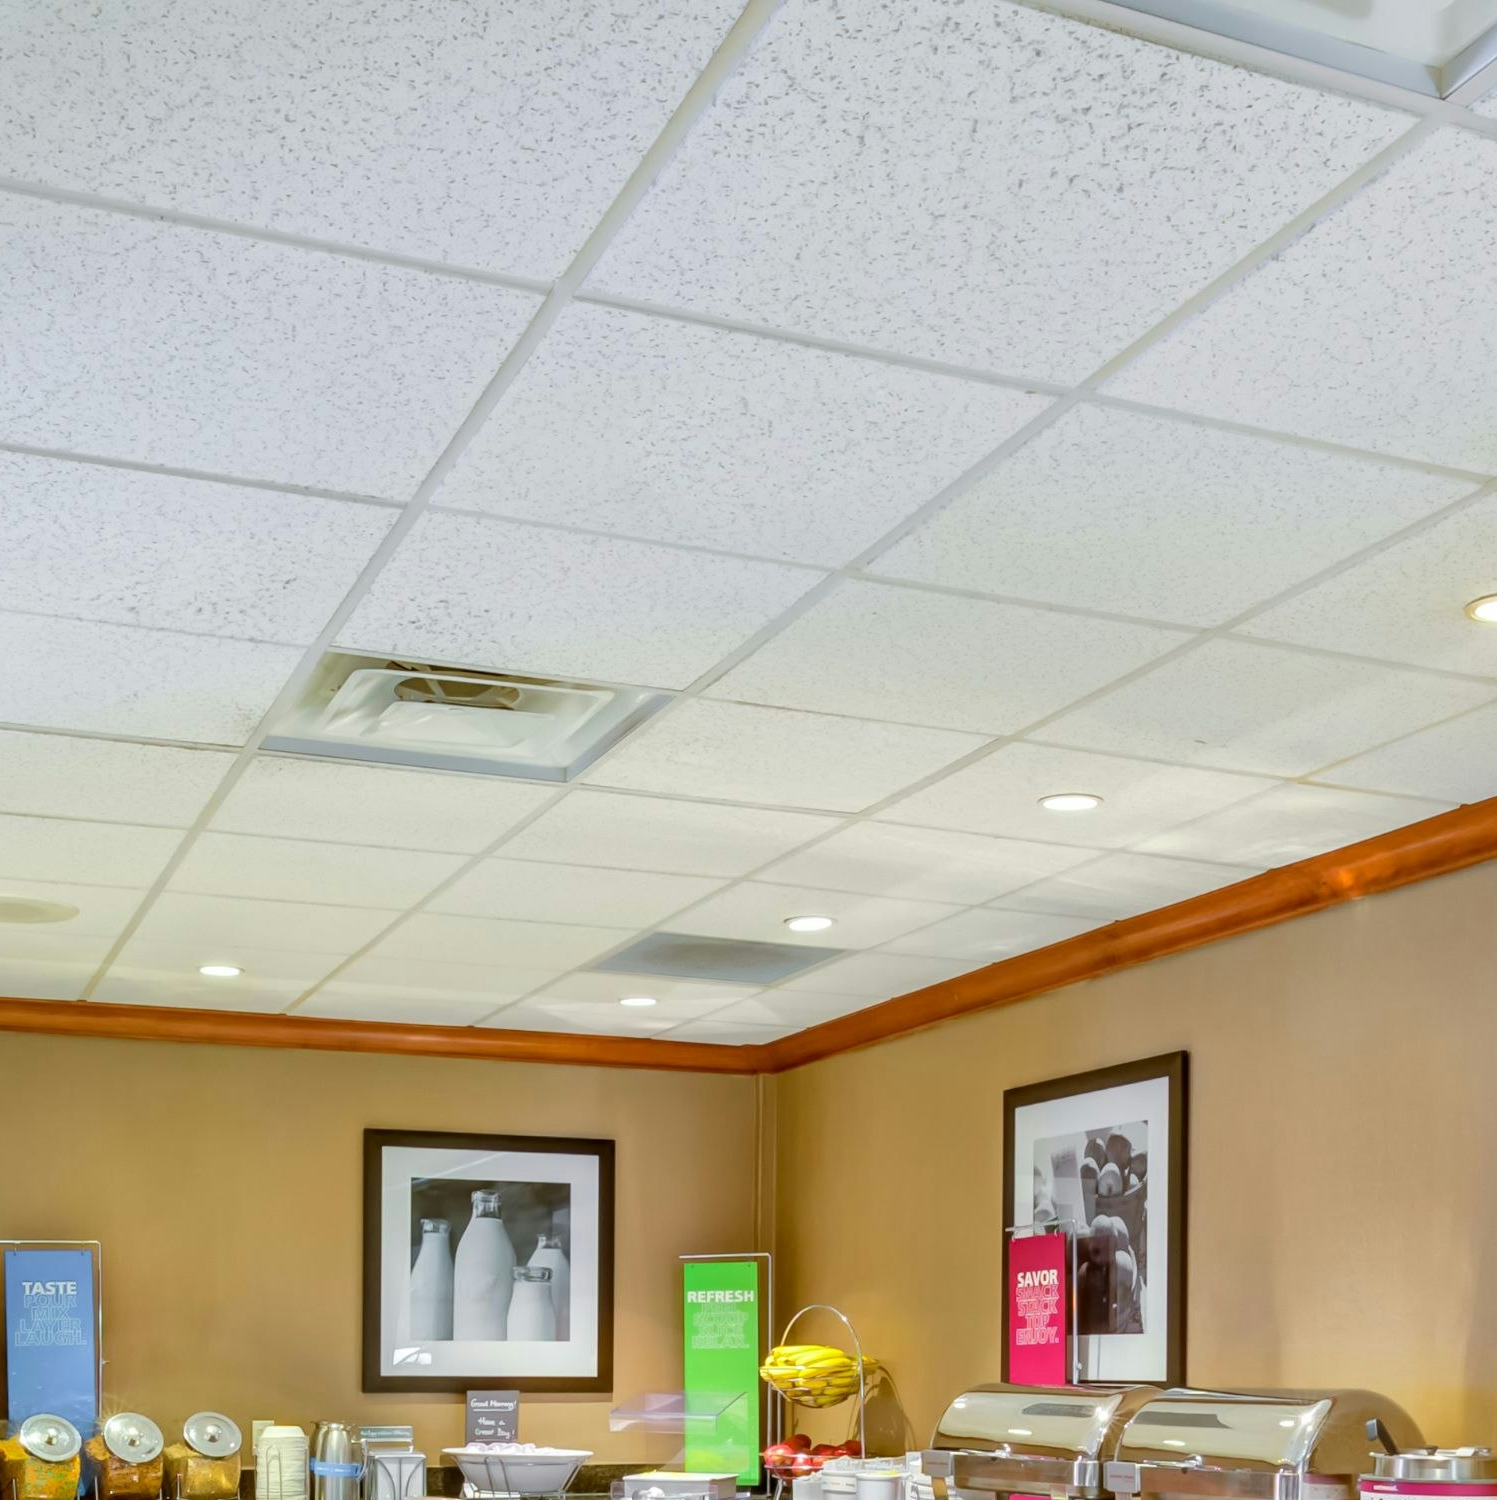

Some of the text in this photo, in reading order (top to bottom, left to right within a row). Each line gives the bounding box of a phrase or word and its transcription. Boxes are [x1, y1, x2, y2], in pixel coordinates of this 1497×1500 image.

[1017, 1269, 1059, 1288] SAVOR
[22, 1281, 78, 1295] TASTE
[1016, 1284, 1059, 1302] SNACK
[23, 1294, 78, 1308] POUR
[687, 1290, 755, 1303] REFRESH
[31, 1306, 71, 1320] MIX
[1017, 1299, 1058, 1317] STACK
[20, 1318, 82, 1333] LAYER
[1025, 1313, 1050, 1329] TOP
[14, 1330, 88, 1346] LAUGH.
[1016, 1327, 1060, 1346] ENJOY.
[470, 1398, 489, 1408] Good
